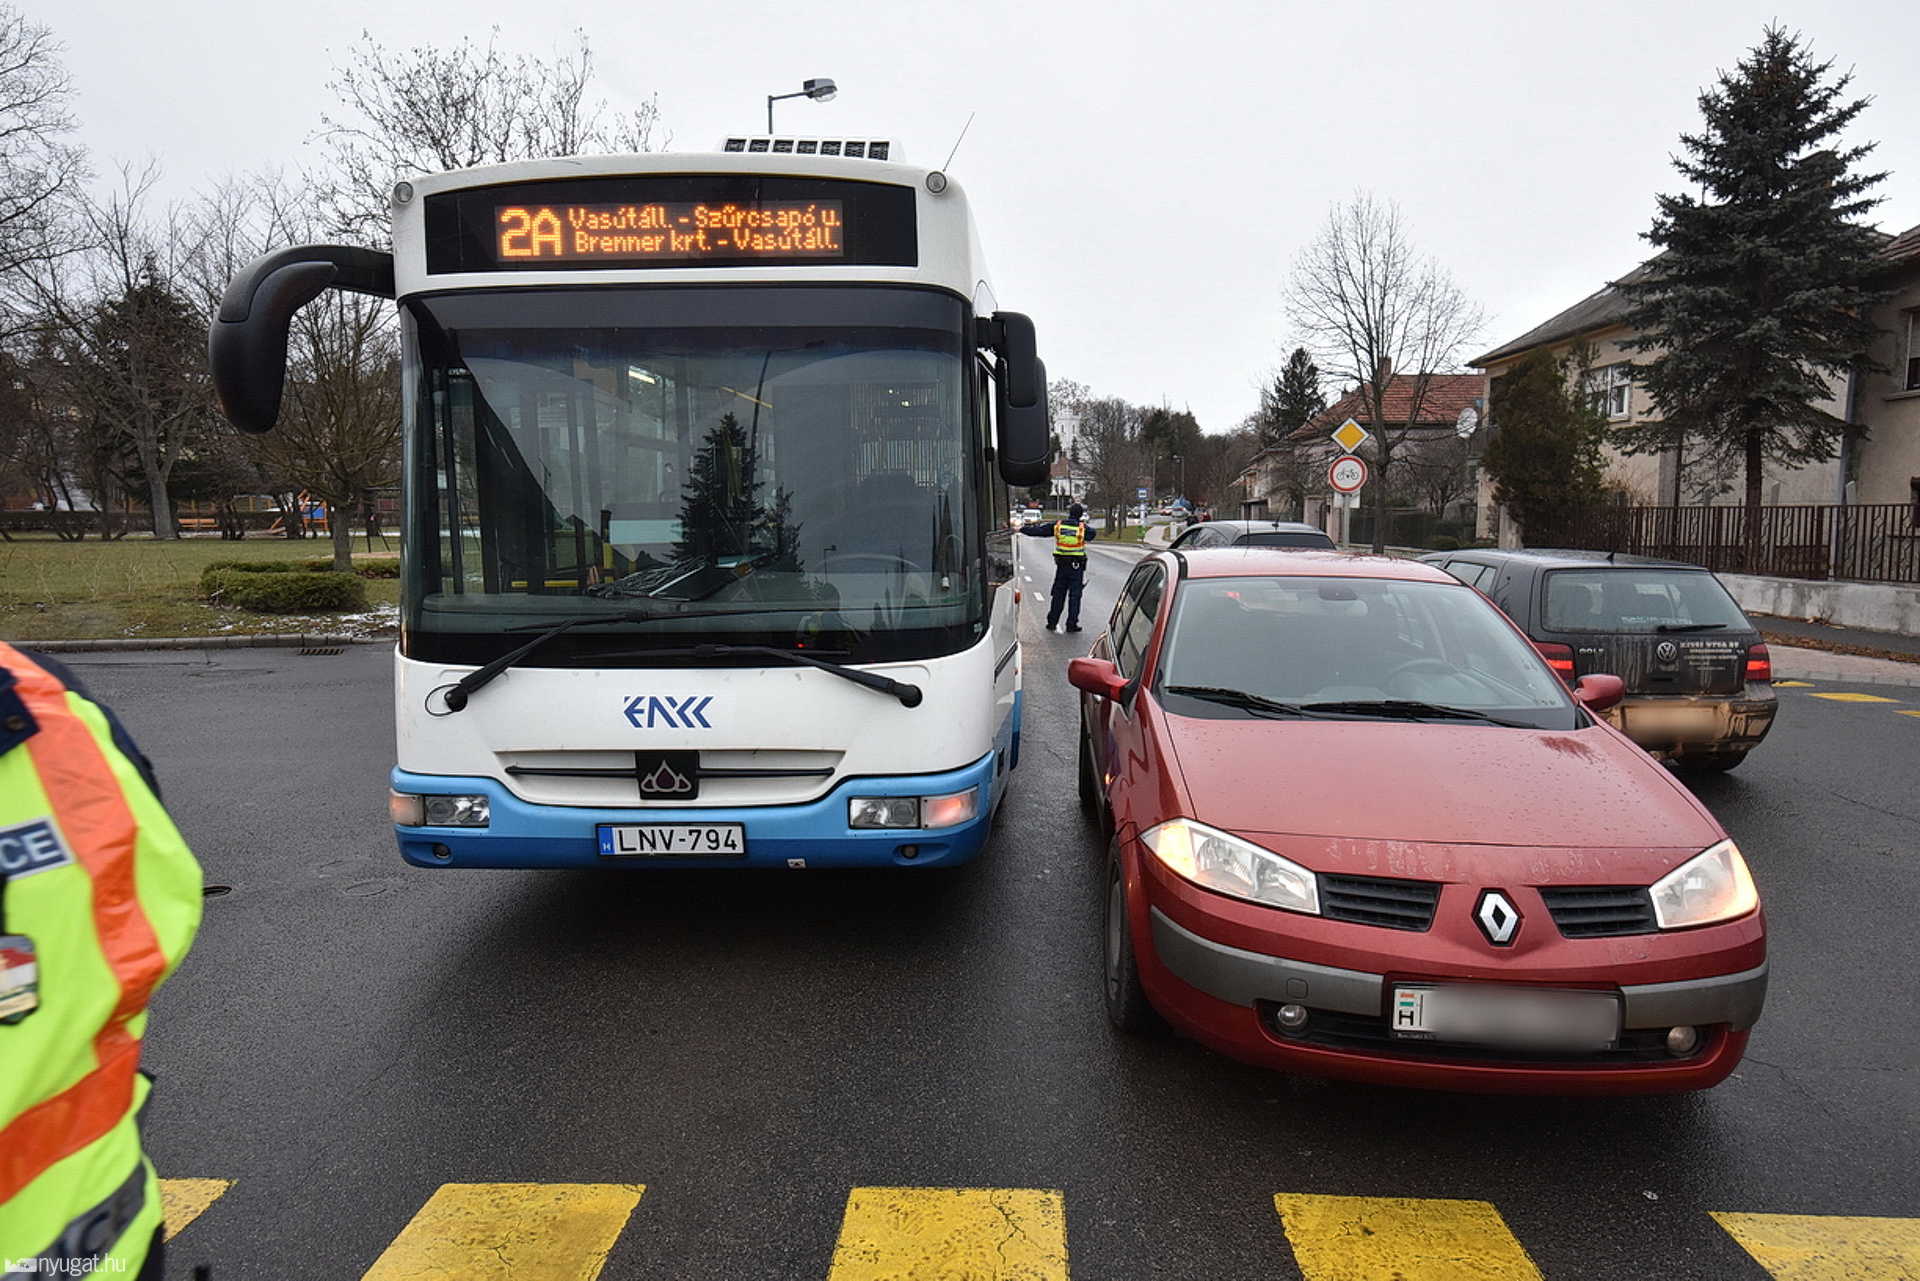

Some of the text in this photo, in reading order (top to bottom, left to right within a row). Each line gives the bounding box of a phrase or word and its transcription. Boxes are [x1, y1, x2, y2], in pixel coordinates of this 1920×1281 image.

[568, 203, 673, 229] Vasútáll.
[822, 209, 841, 227] u.
[500, 208, 562, 257] 2A
[575, 231, 665, 252] Brenner
[670, 230, 712, 252] krt.
[733, 226, 839, 251] Vasútáll.
[618, 828, 738, 852] LNV-794
[1398, 1009, 1414, 1027] H
